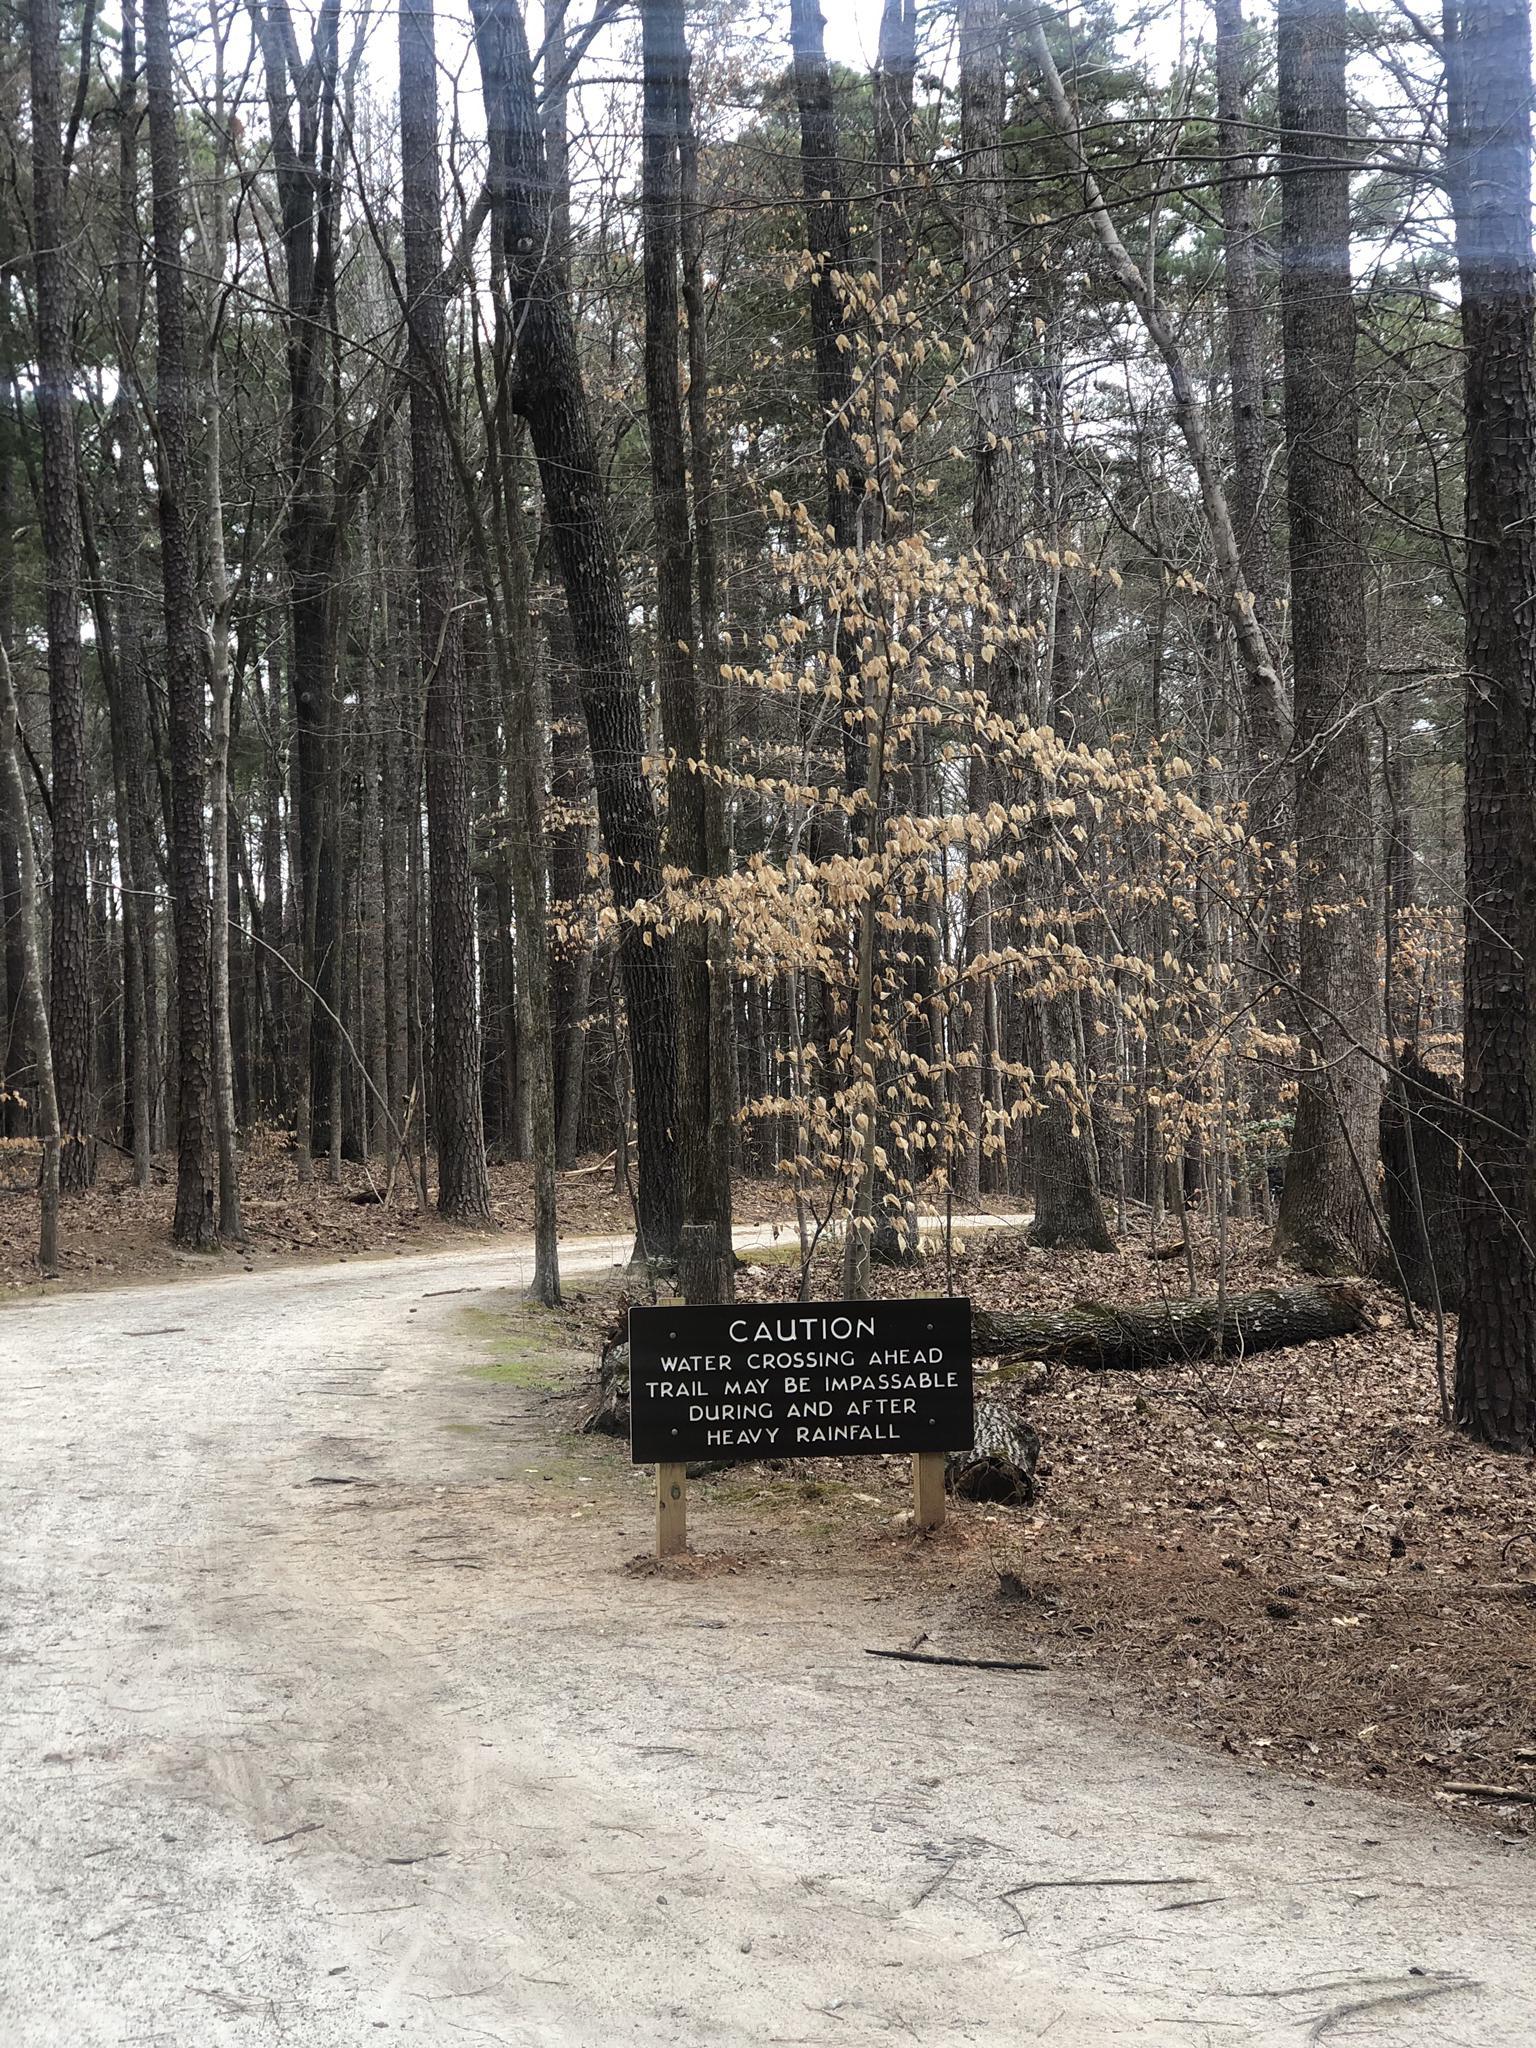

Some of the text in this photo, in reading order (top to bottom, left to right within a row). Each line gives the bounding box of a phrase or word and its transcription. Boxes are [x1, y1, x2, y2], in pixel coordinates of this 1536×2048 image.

[729, 1316, 875, 1343] CAUTION
[660, 1347, 943, 1372] WATER CROSSING AHEAD
[645, 1372, 959, 1398] TRAIL MAY BE IMPASSABLE
[689, 1398, 917, 1422] DURING AND AFTER
[707, 1423, 901, 1446] HEAVY RAINFALL
